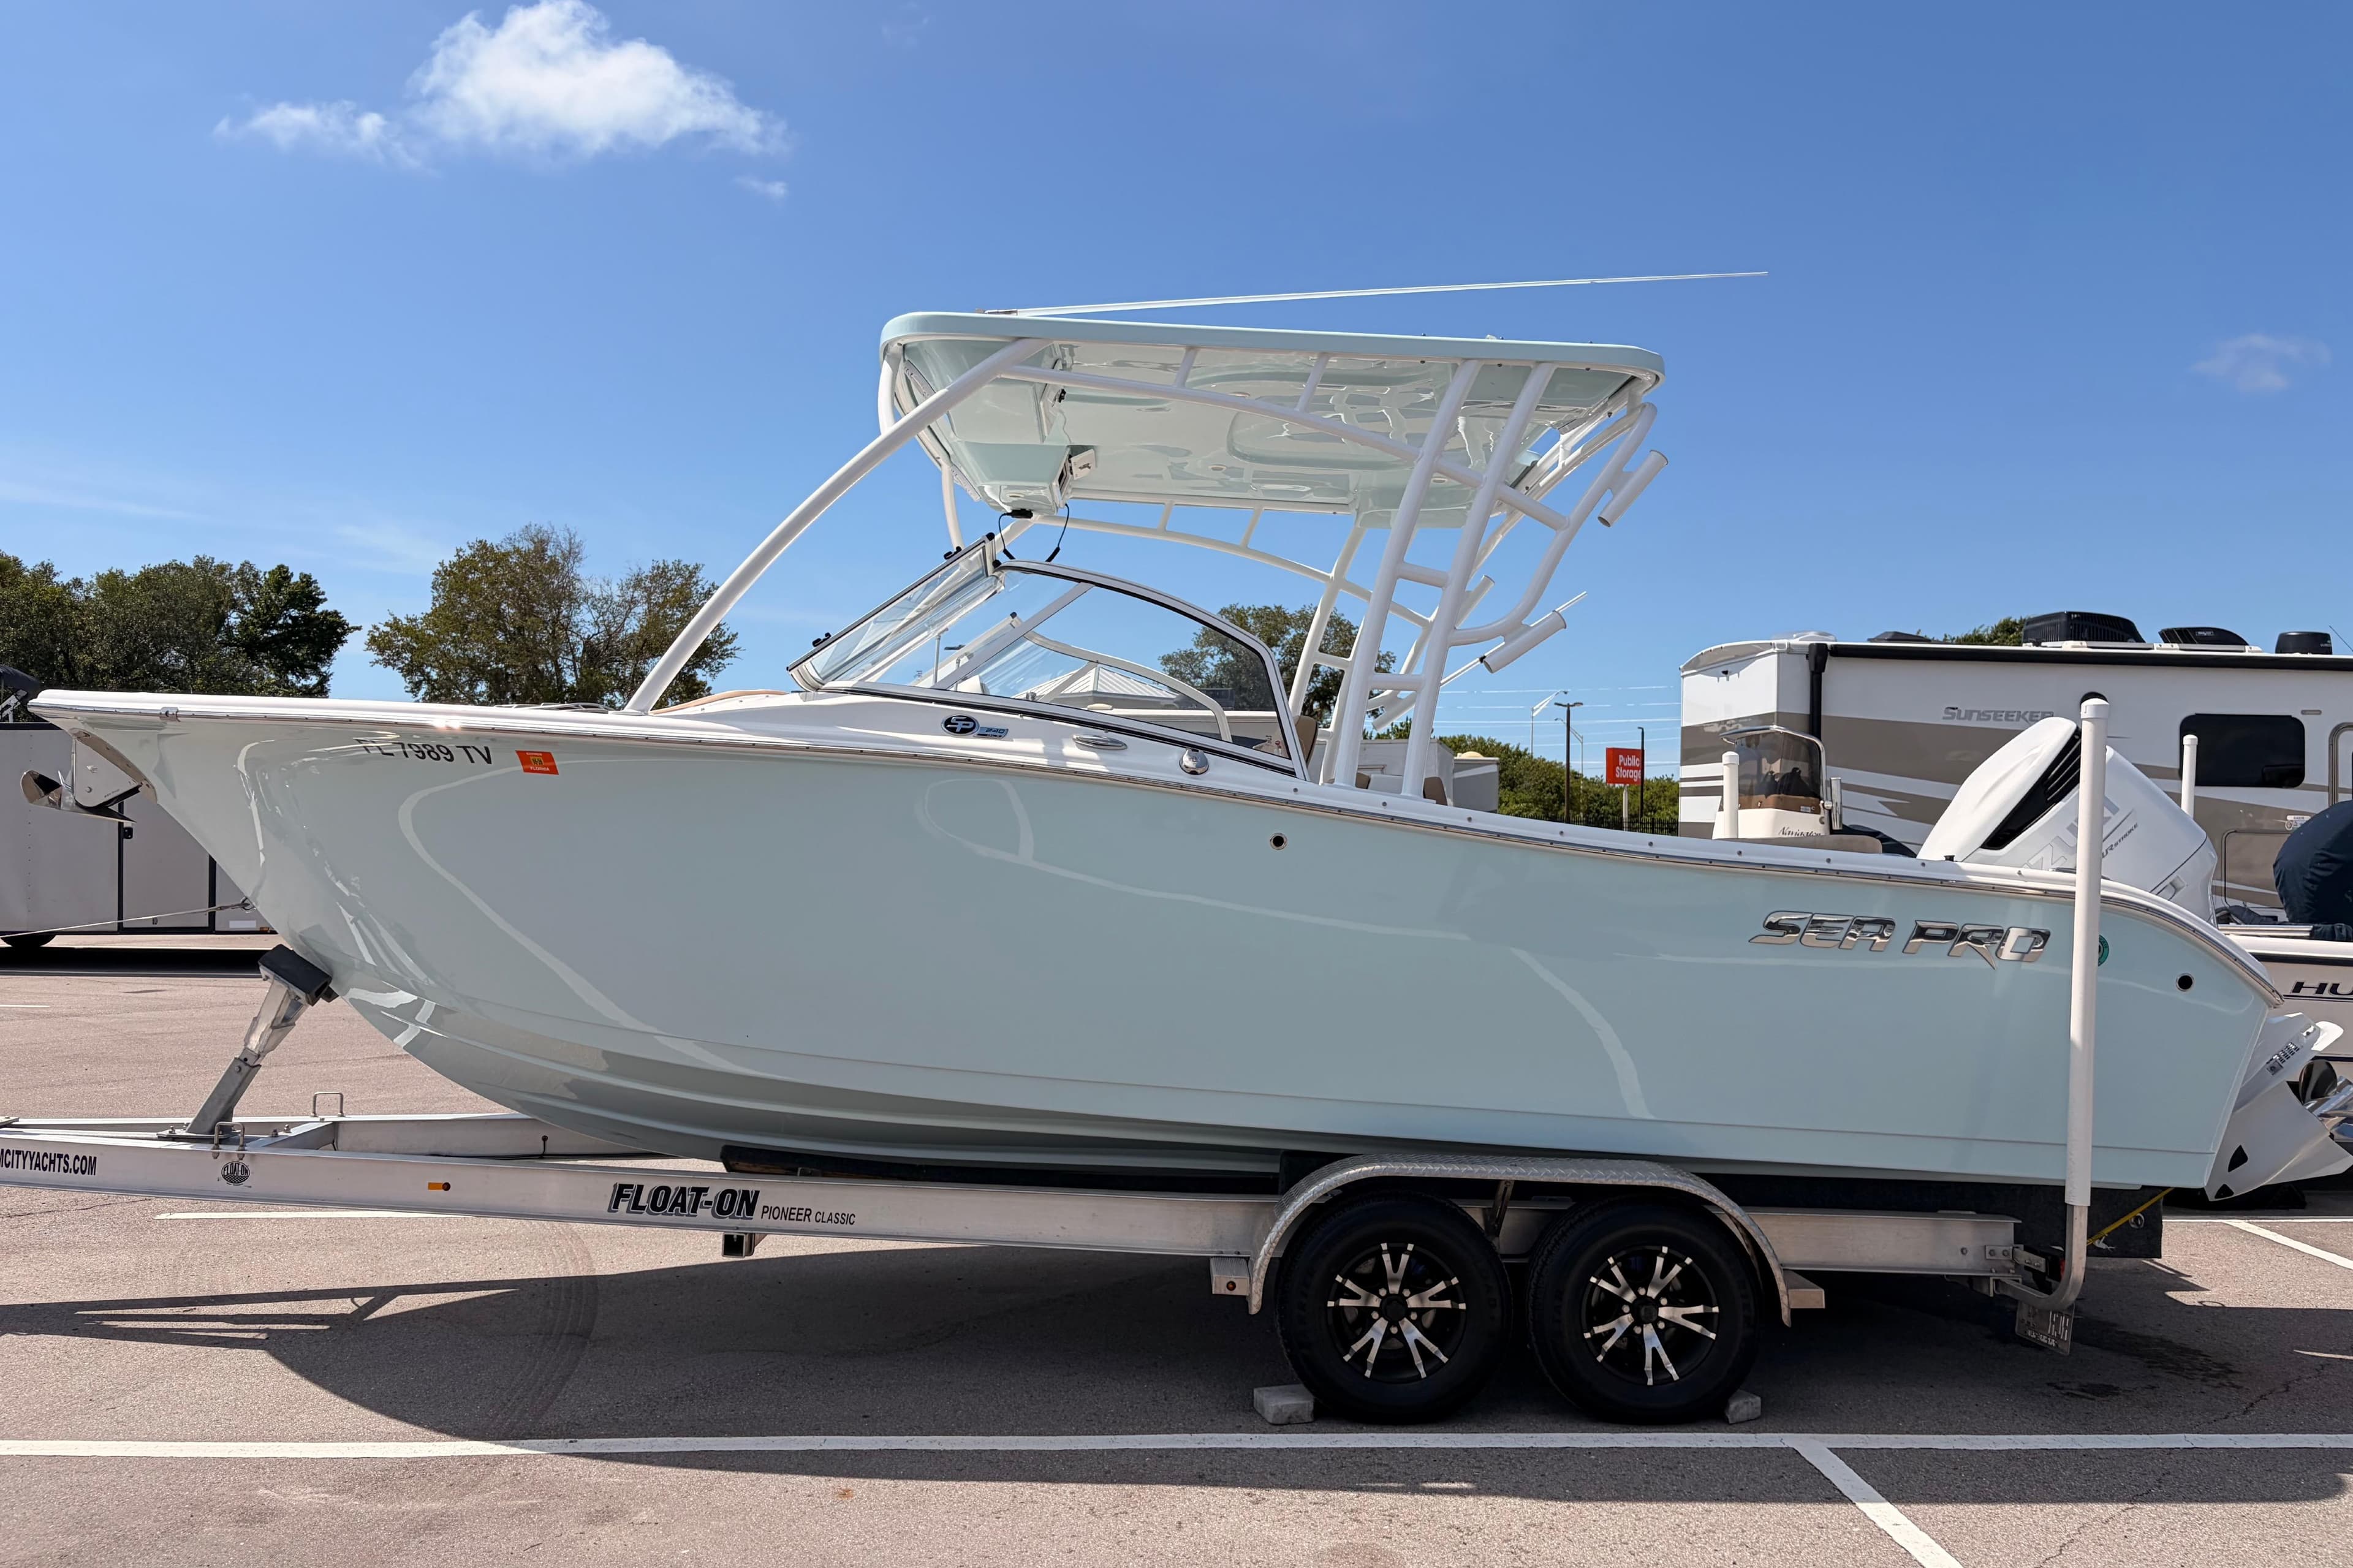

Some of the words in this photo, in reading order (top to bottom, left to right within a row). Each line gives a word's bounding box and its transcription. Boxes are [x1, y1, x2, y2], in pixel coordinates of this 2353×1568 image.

[354, 738, 395, 756] FL
[392, 742, 455, 763] 7989
[456, 745, 493, 765] TV
[1618, 754, 1640, 767] Public
[1615, 767, 1642, 782] Storage
[1749, 911, 1896, 952] SEA
[1902, 920, 2051, 970] PRO
[2292, 981, 2353, 996] HU
[608, 1182, 760, 1221] FLOAT-ON
[760, 1205, 812, 1222] PIONEER
[814, 1210, 856, 1225] CLASSIC
